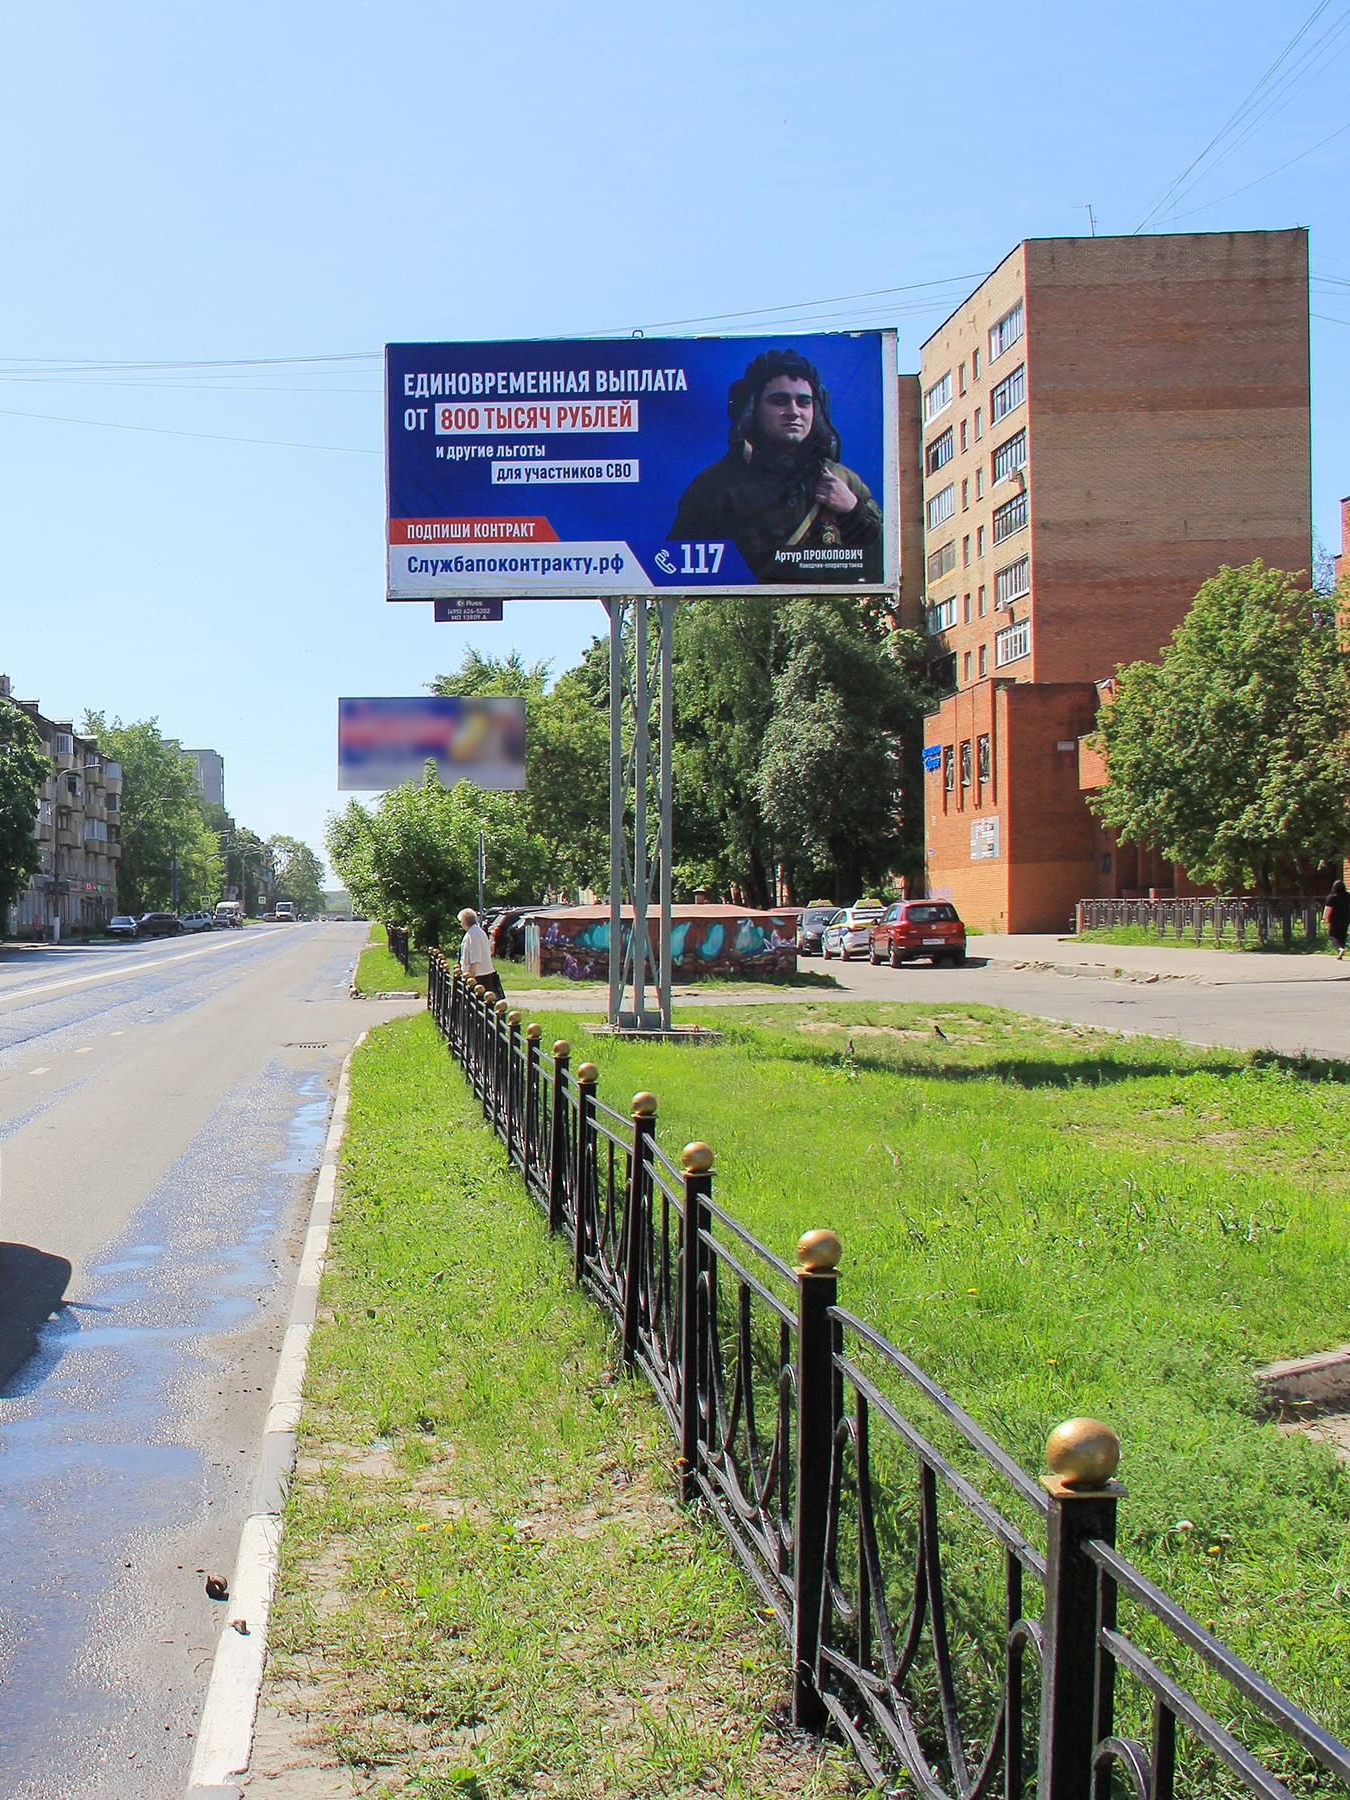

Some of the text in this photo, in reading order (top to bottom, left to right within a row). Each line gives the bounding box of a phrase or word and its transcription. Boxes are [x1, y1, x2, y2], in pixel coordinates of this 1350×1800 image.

[403, 369, 687, 398] ЕДИНОВРЕМЕННАЯ ВЫПЛАТА
[404, 399, 632, 431] ОТ 800 ТЫСЯЧ РУБЛЕЙ
[436, 443, 546, 461] и другие льготы
[496, 463, 631, 482] для участников СВО
[407, 523, 535, 540] ПОДПИШИ КОНТРАКТ
[407, 554, 624, 577] Службапоконтракту.рф
[680, 543, 724, 574] 117
[775, 549, 863, 563] Артур ПРОКОПОВИЧ
